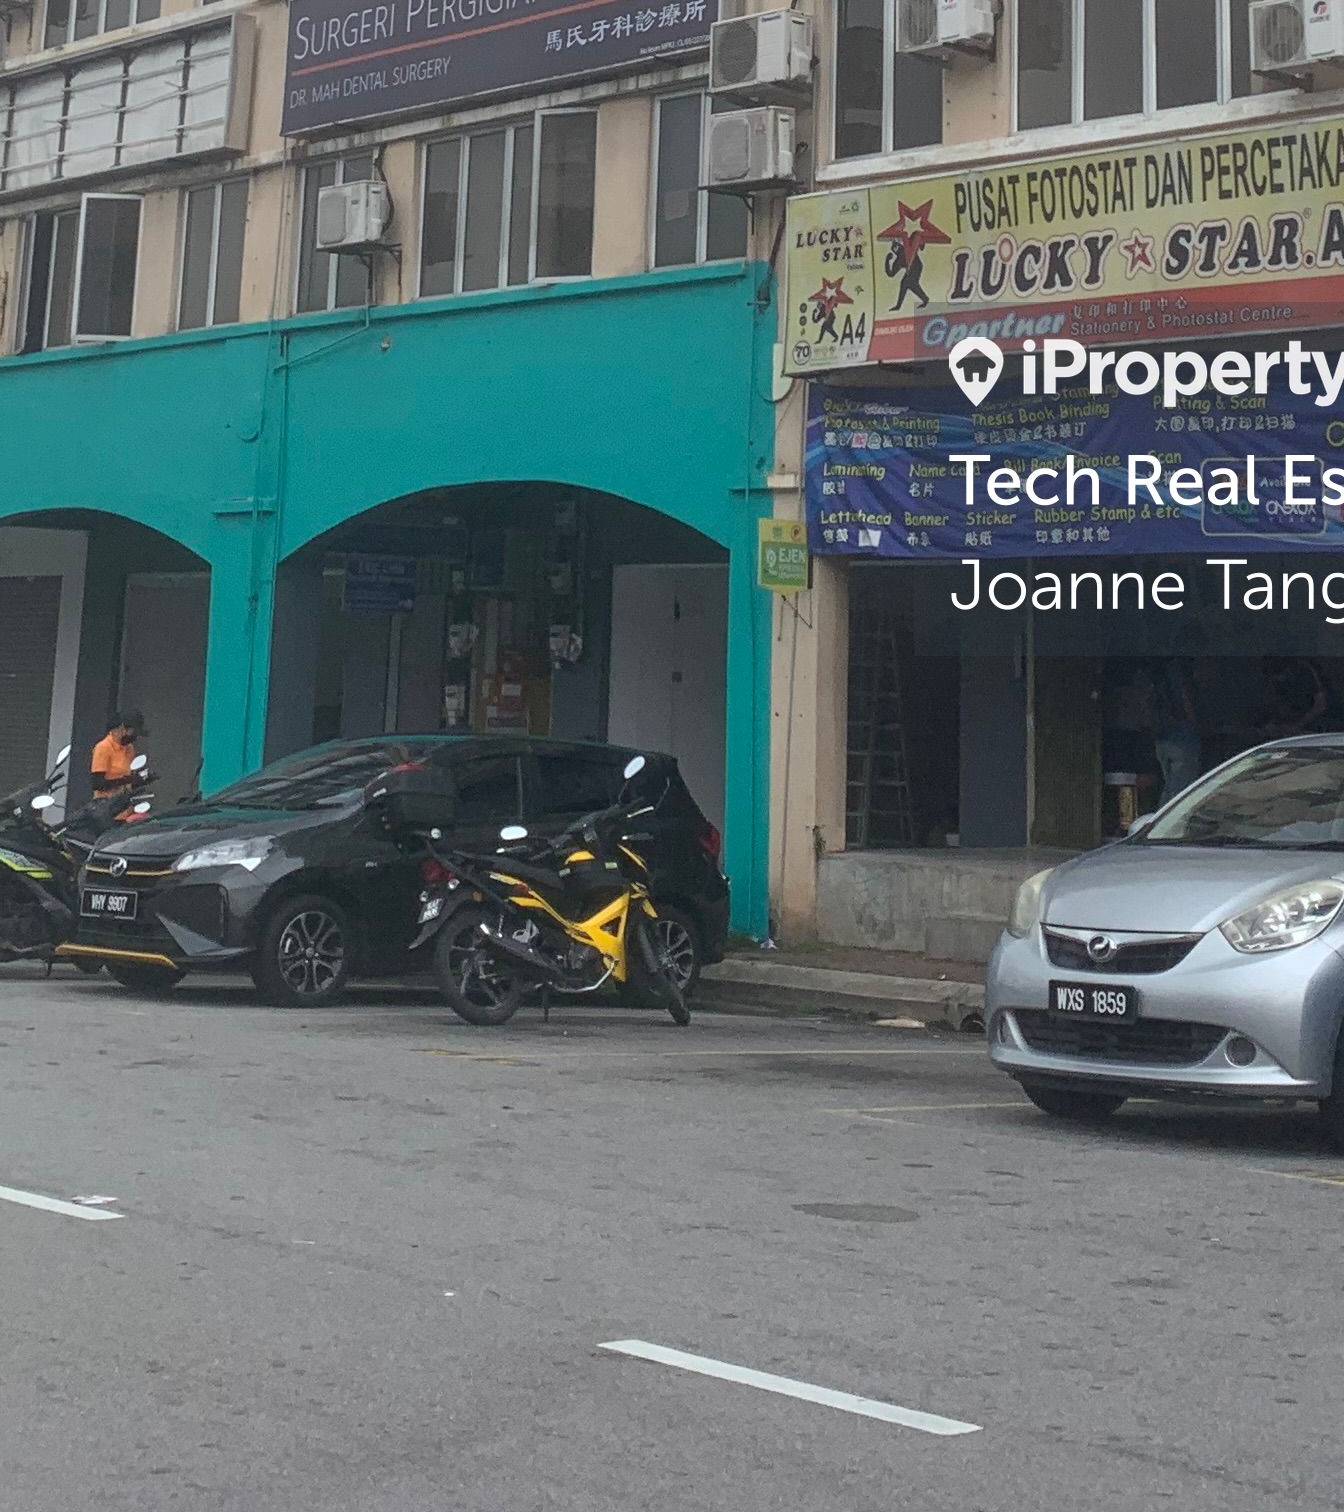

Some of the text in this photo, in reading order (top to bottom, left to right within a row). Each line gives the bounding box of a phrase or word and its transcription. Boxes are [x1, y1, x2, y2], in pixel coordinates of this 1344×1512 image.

[293, 3, 396, 61] SURGERI
[312, 78, 340, 104] MAH
[343, 70, 389, 98] DENTAL
[392, 55, 452, 86] SURGERY
[955, 173, 1020, 235] PUSAT
[1027, 156, 1139, 226] FOTOSTAT
[1144, 149, 1193, 209] DAN
[795, 224, 854, 249] LUCKY
[821, 243, 864, 263] STAR
[949, 232, 1114, 301] LUCKY
[839, 311, 866, 346] A4
[922, 304, 1292, 351] Gpartner Stationery & Photostat Centre
[796, 345, 810, 358] 70
[971, 413, 1015, 427] Thesis
[1018, 406, 1056, 424] Book
[1059, 401, 1110, 418] Binding
[1230, 393, 1266, 410] Scan
[892, 418, 941, 431] Printing
[908, 463, 946, 478] Name
[904, 511, 950, 527] Banner
[965, 510, 1017, 526] Sticker
[1034, 508, 1086, 524] Rubber
[1090, 507, 1137, 524] Stamp
[1140, 504, 1151, 520] &
[1156, 504, 1181, 519] etc
[1056, 987, 1127, 1016] WXS 1859
